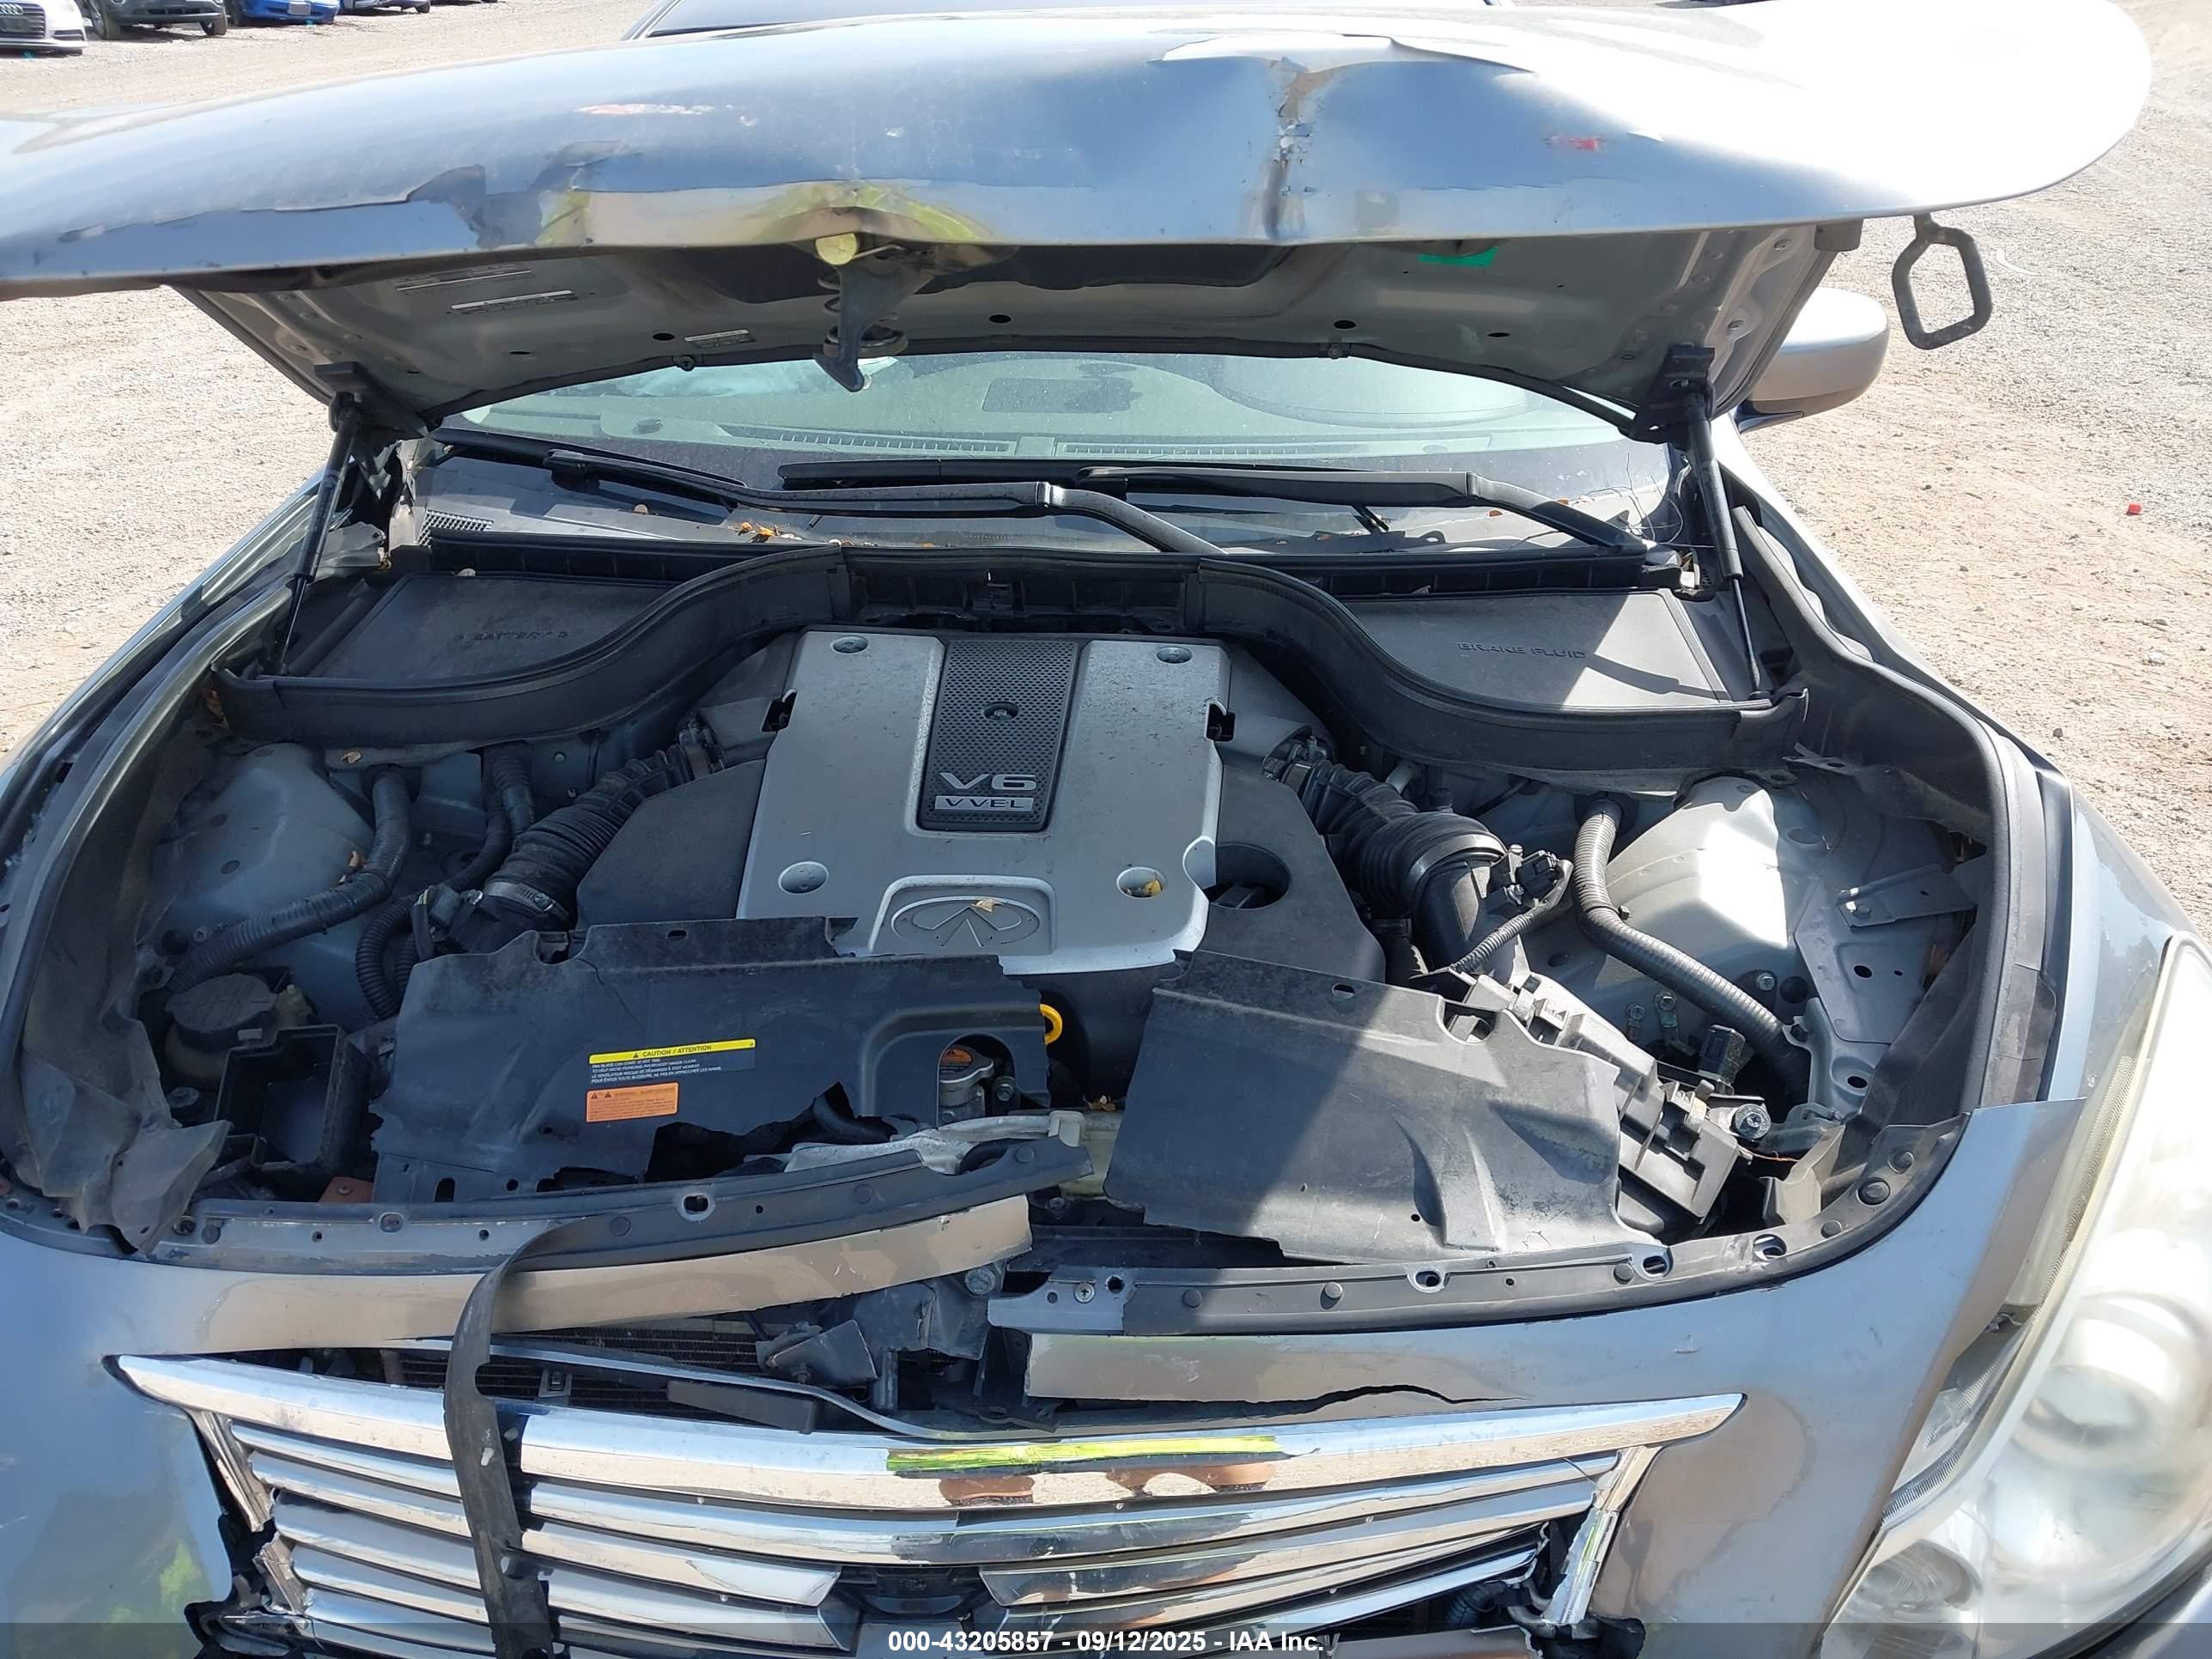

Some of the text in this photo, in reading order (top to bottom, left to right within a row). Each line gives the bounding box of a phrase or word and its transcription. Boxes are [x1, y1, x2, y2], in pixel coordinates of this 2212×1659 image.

[1457, 642, 1588, 659] BRAKE FLUID
[939, 772, 1037, 791] V6
[945, 798, 1024, 809] VVEL
[678, 1045, 712, 1054] ATTENTION
